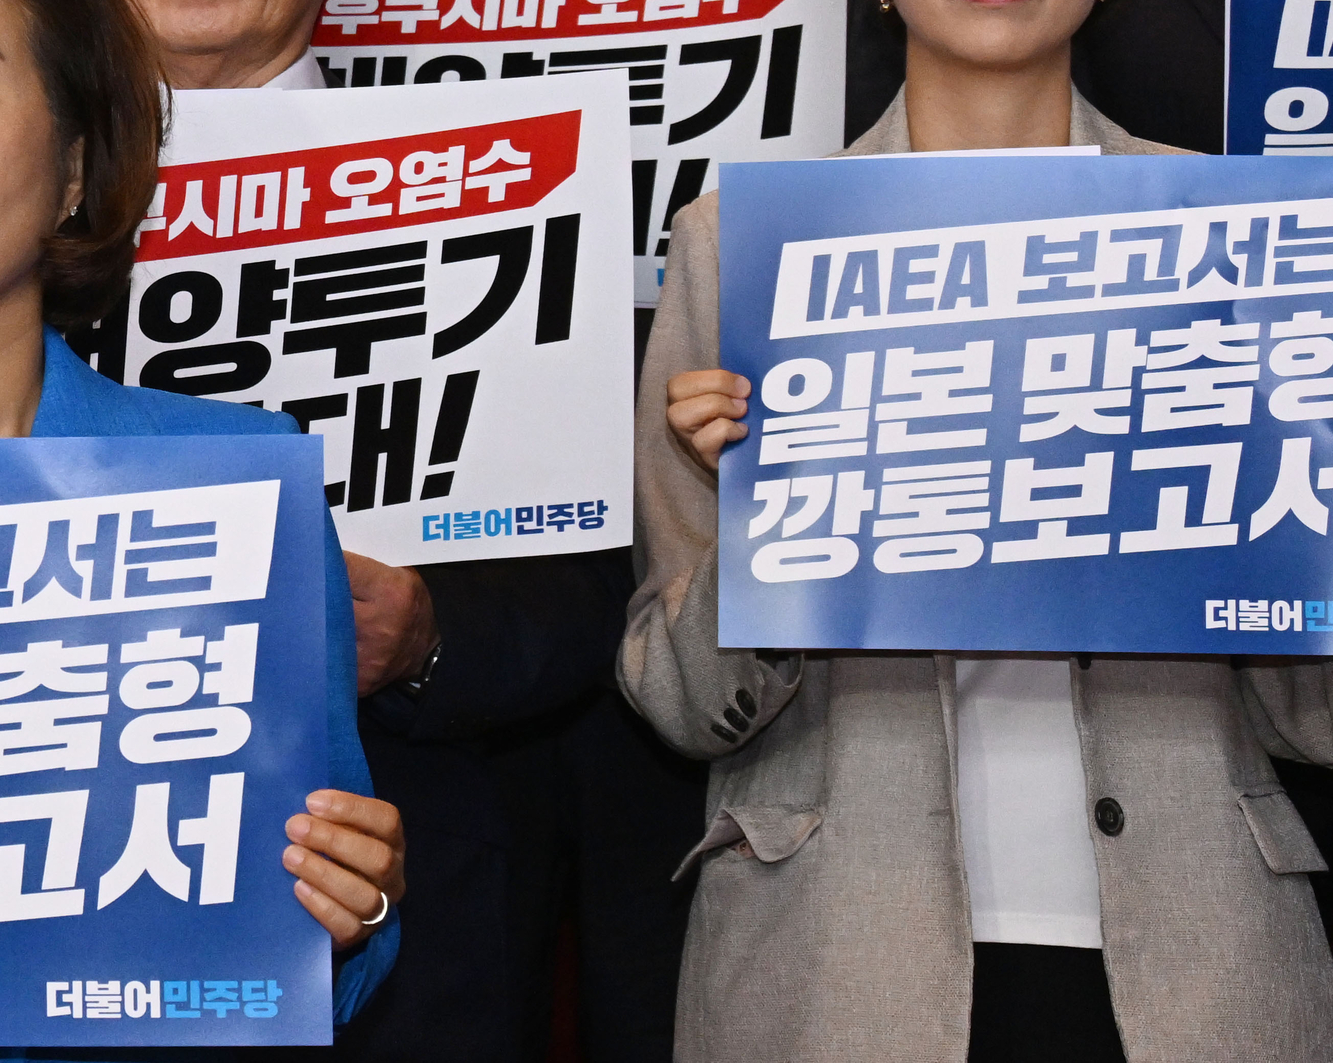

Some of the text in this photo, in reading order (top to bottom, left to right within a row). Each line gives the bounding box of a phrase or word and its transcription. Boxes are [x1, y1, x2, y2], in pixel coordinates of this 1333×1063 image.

[324, 139, 532, 226] 오염수
[806, 213, 1333, 323] IAEA 보고서는
[758, 339, 995, 466] 일본
[422, 500, 608, 542] 더불어민주당
[1205, 599, 1333, 632] 더불어민
[46, 980, 284, 1021] 더불어민주당
